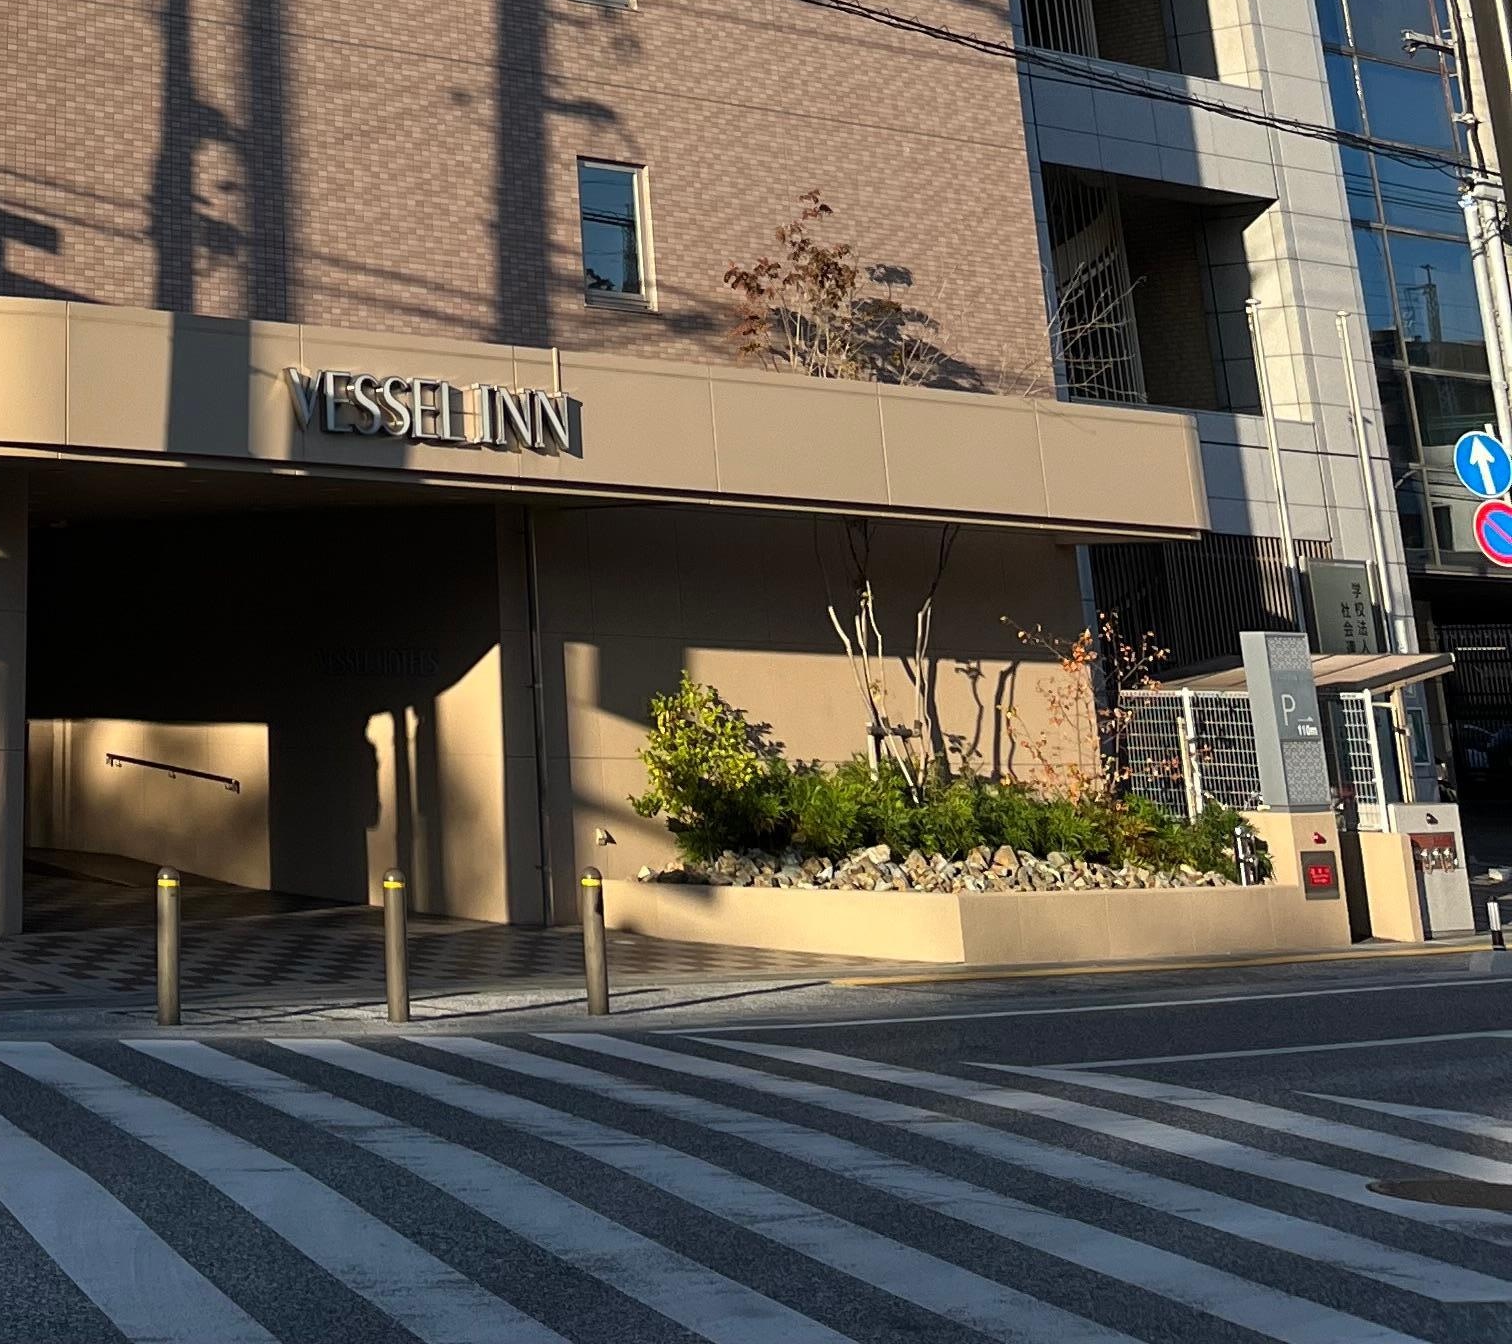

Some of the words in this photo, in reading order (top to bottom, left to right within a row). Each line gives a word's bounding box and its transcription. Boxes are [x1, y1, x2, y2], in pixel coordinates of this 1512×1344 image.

[285, 367, 466, 442] VESSEL
[472, 382, 570, 450] INN
[1281, 694, 1296, 727] P
